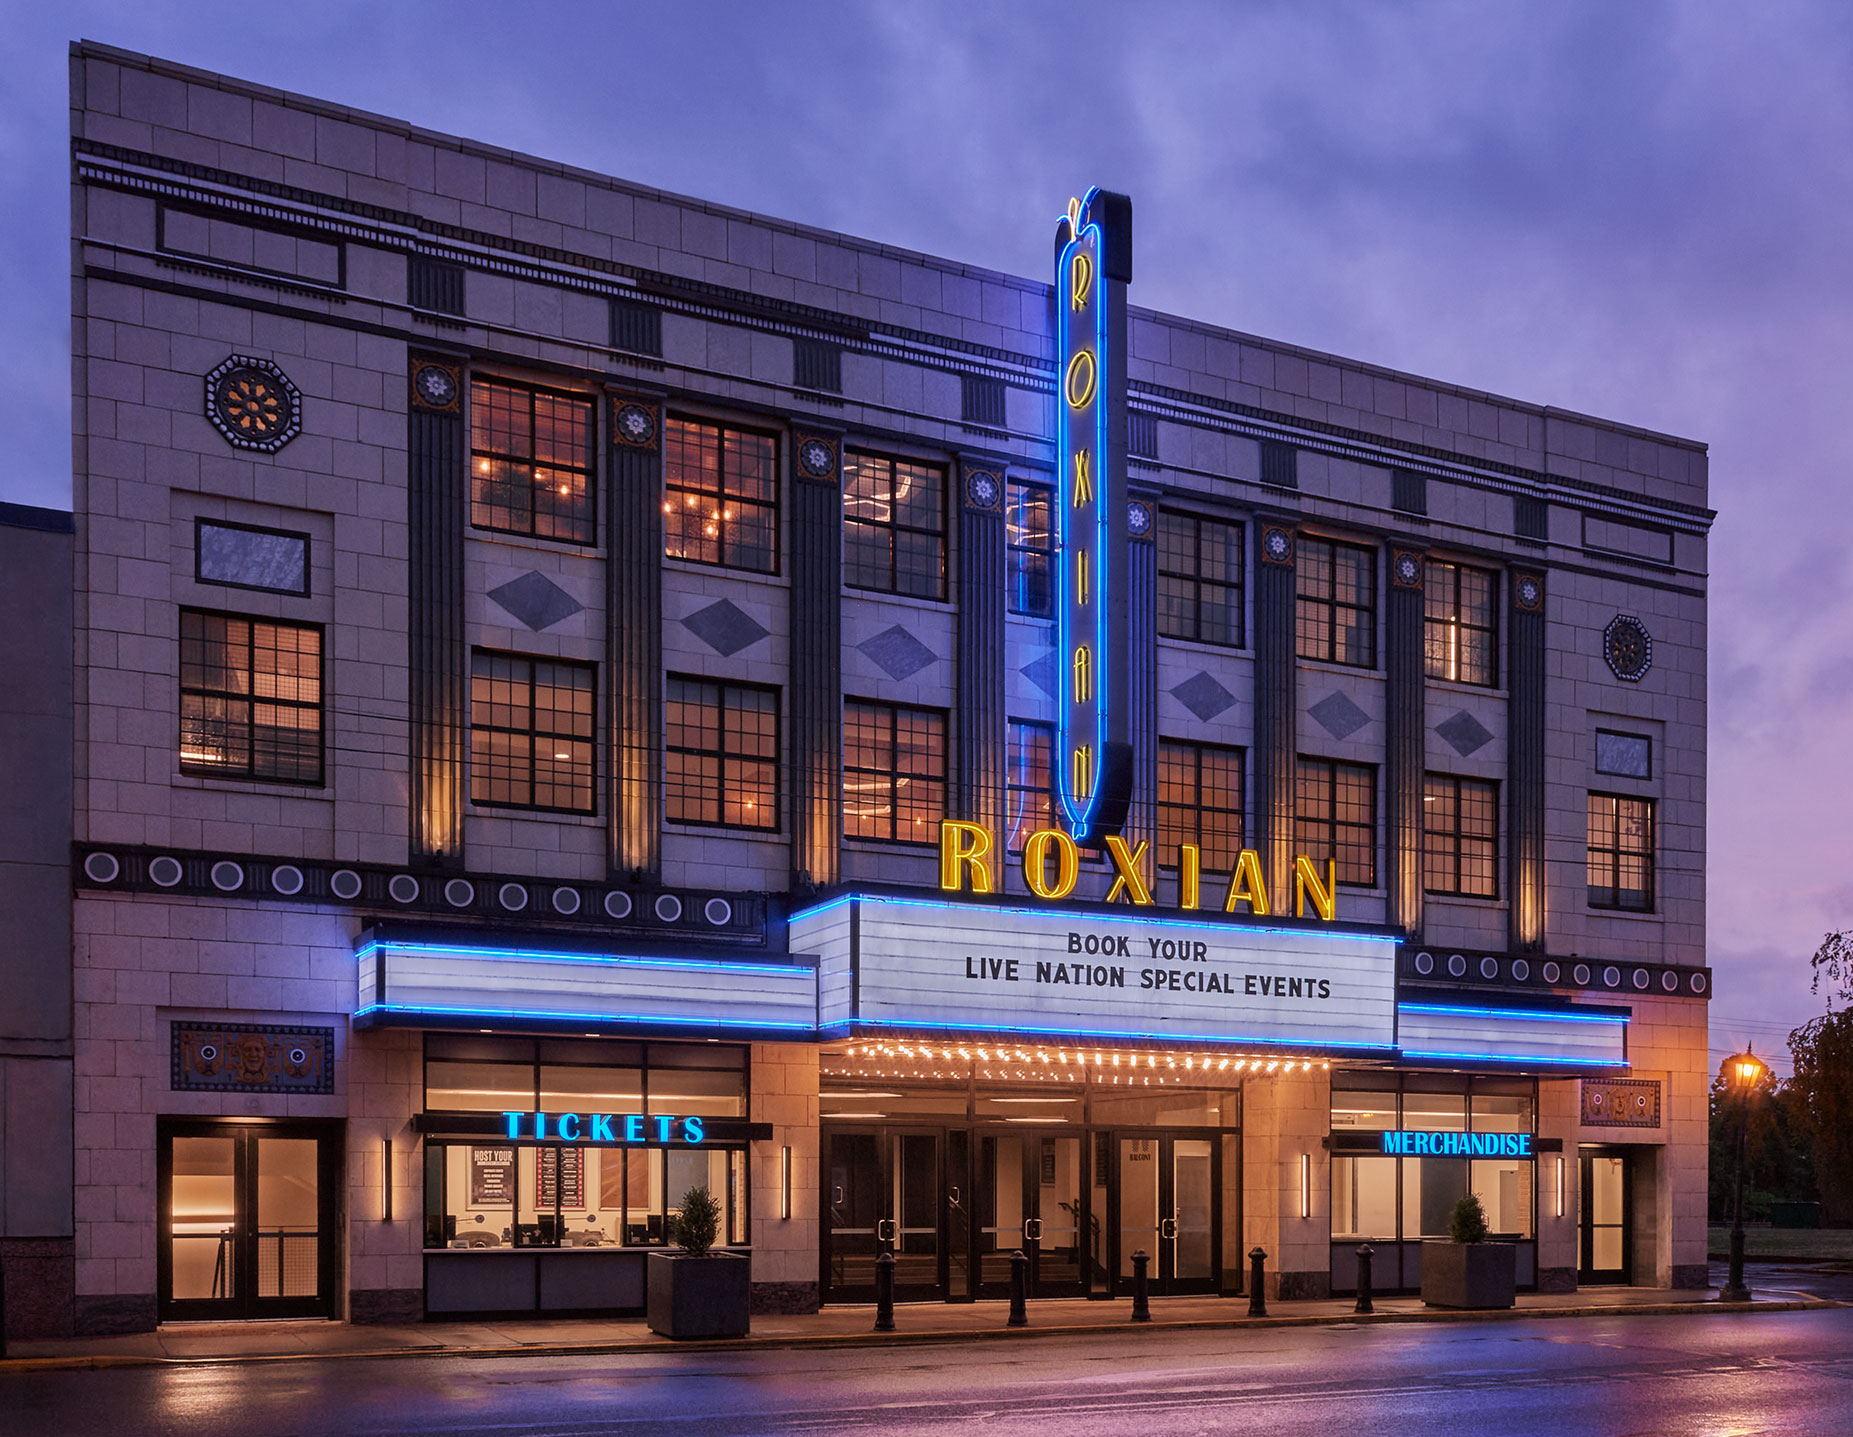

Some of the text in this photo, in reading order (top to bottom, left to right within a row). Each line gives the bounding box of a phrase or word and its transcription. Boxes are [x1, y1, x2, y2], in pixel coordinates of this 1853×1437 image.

[1065, 254, 1098, 803] ROXIAN
[939, 819, 1337, 921] ROXIAN
[1067, 932, 1207, 962] BOOK YOUR
[965, 956, 1331, 999] LIVE NATION SPECIAL EVENTS
[502, 1112, 704, 1143] TICKETS
[474, 1150, 513, 1162] HOST YOUR
[1384, 1131, 1532, 1156] MERCHANDISE
